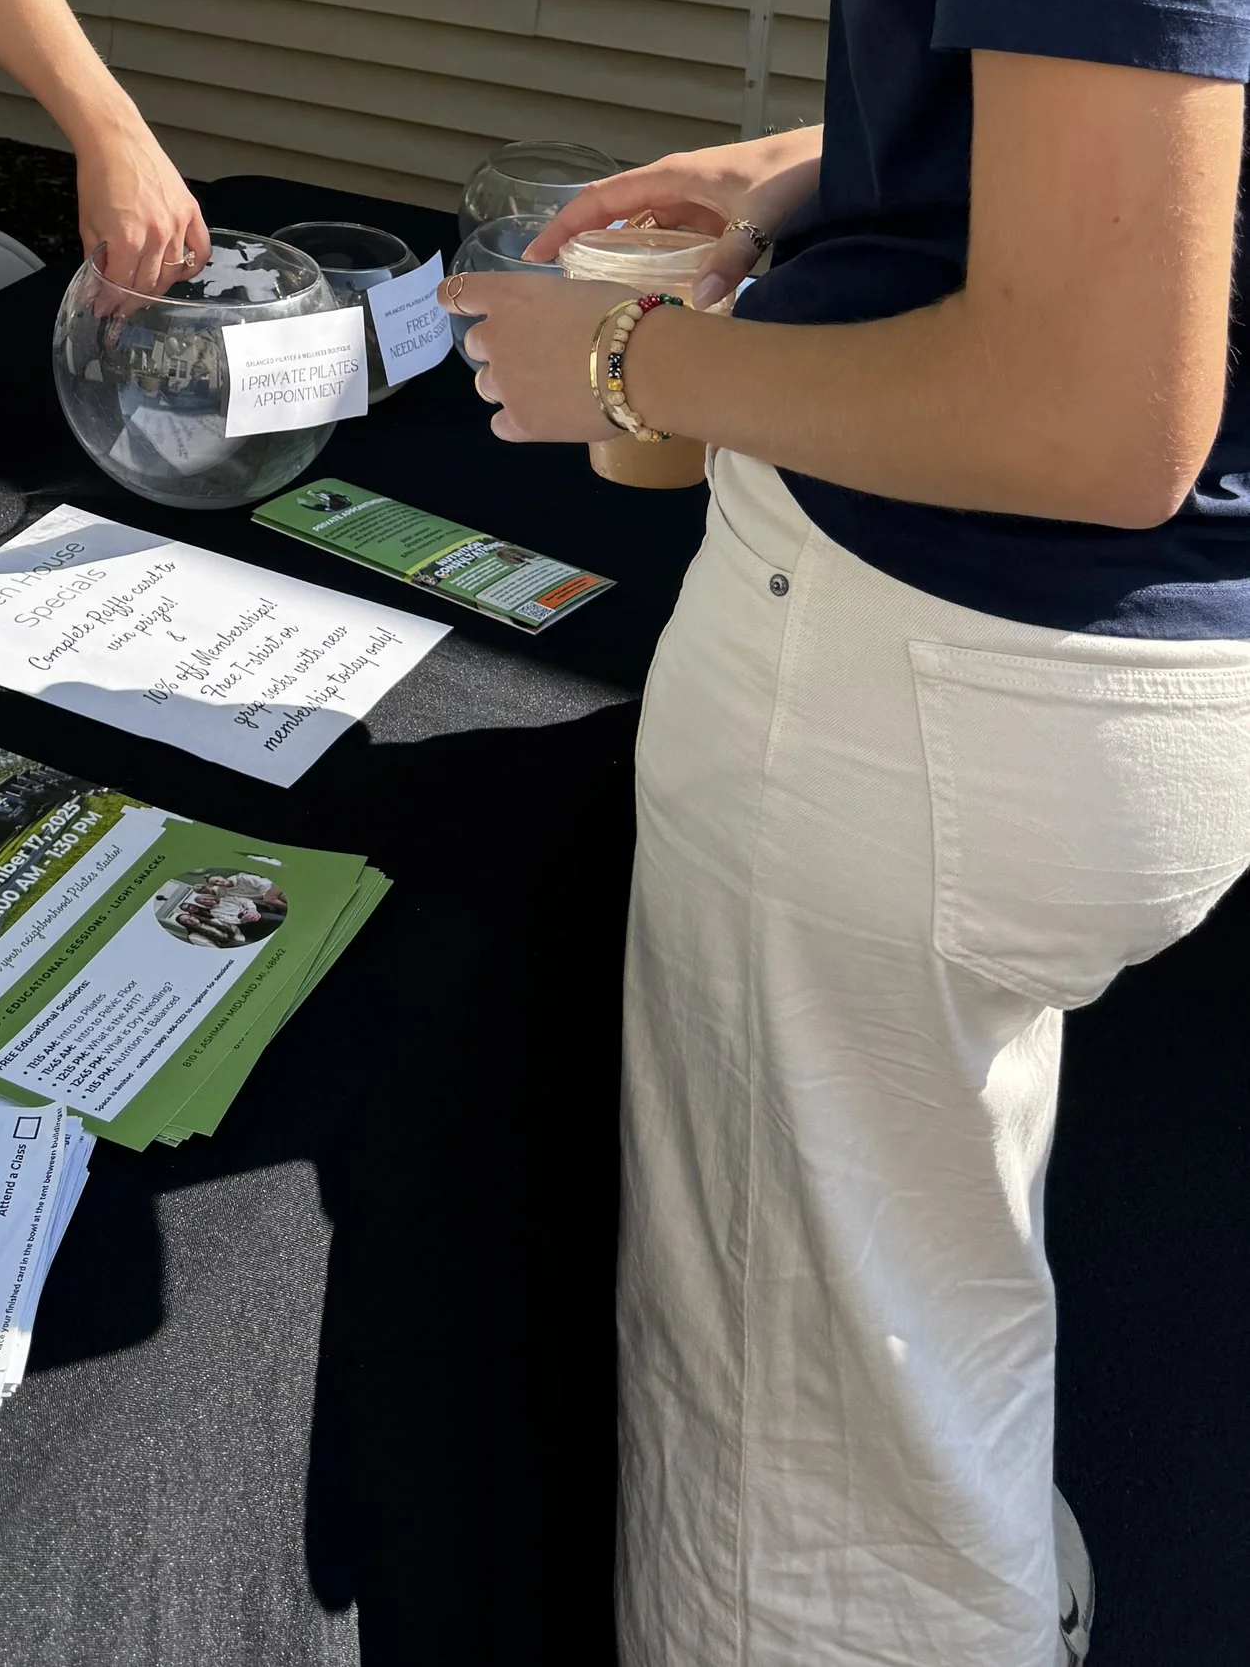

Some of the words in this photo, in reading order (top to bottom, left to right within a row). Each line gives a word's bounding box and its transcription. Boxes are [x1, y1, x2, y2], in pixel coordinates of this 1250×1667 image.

[406, 313, 430, 334] FREE
[390, 331, 433, 360] NEEDLING
[249, 368, 306, 390] PRIVATE
[309, 359, 359, 381] PILATES
[253, 380, 344, 409] APPOINTMENT
[11, 541, 86, 586] House
[436, 540, 485, 567] NUTRITION
[14, 568, 107, 627] Specials
[28, 620, 95, 671] Complete
[86, 593, 134, 625] Raffle
[131, 567, 163, 595] card
[155, 561, 176, 573] to
[107, 630, 136, 651] win
[136, 595, 179, 636] prizes!
[191, 597, 278, 667] Memberships!
[166, 630, 187, 643] &
[176, 659, 210, 681] off
[200, 673, 242, 699] Free
[230, 634, 283, 676] T-shirt
[280, 625, 300, 639] or
[234, 698, 272, 729] grip
[264, 672, 298, 701] socks
[294, 646, 325, 674] with
[322, 625, 349, 650] new
[143, 678, 179, 705] 10%
[263, 684, 346, 752] membership
[327, 655, 380, 687] today
[368, 626, 404, 657] only!
[41, 801, 81, 835] 2025
[14, 864, 47, 892] AM
[44, 832, 79, 859] 1:30
[71, 810, 103, 834] PM
[1, 946, 23, 968] your
[21, 895, 73, 949] neighborhood
[66, 871, 99, 899] Pilates
[7, 953, 68, 1015] EDUCATIONAL
[66, 914, 107, 955] SESSIONS
[110, 885, 136, 909] LIGHT
[134, 853, 166, 886] SNACKS
[266, 948, 287, 970] 48642
[15, 1010, 60, 1053] Educational
[55, 979, 91, 1012] Sessions:
[27, 1052, 48, 1070] 11:15
[43, 1039, 62, 1056] AM:
[56, 1024, 77, 1042] Intro
[74, 1015, 85, 1026] to
[81, 993, 107, 1017] Pilates
[41, 1058, 62, 1076] 11:45
[59, 1043, 77, 1059] AM:
[74, 1026, 95, 1043] Intro
[93, 1017, 103, 1027] to
[98, 998, 122, 1019] Pelvic
[116, 980, 138, 999] Floor
[55, 1064, 76, 1082] 12:15
[73, 1050, 91, 1066] PM:
[85, 1030, 111, 1052] What
[111, 1010, 128, 1026] the
[123, 993, 145, 1014] AFIT?
[70, 1069, 93, 1088] 12:45
[88, 1053, 107, 1071] PM:
[101, 1034, 126, 1055] What
[127, 1015, 145, 1030] Dry
[140, 981, 175, 1016] Needling?
[85, 1077, 102, 1094] 1:15
[97, 1064, 116, 1081] PM:
[111, 1034, 145, 1067] Nutrition
[141, 1025, 151, 1036] at
[149, 994, 181, 1027] Balanced
[200, 1017, 231, 1050] ASHMAN
[183, 1054, 199, 1068] 810
[196, 1046, 206, 1055] E
[10, 1143, 27, 1171] Class
[43, 1149, 56, 1185] between
[10, 1172, 18, 1180] a
[39, 1185, 49, 1202] tent
[27, 1222, 38, 1241] bowl
[17, 1264, 27, 1284] card
[6, 1284, 21, 1314] finished
[1, 1315, 12, 1333] your
